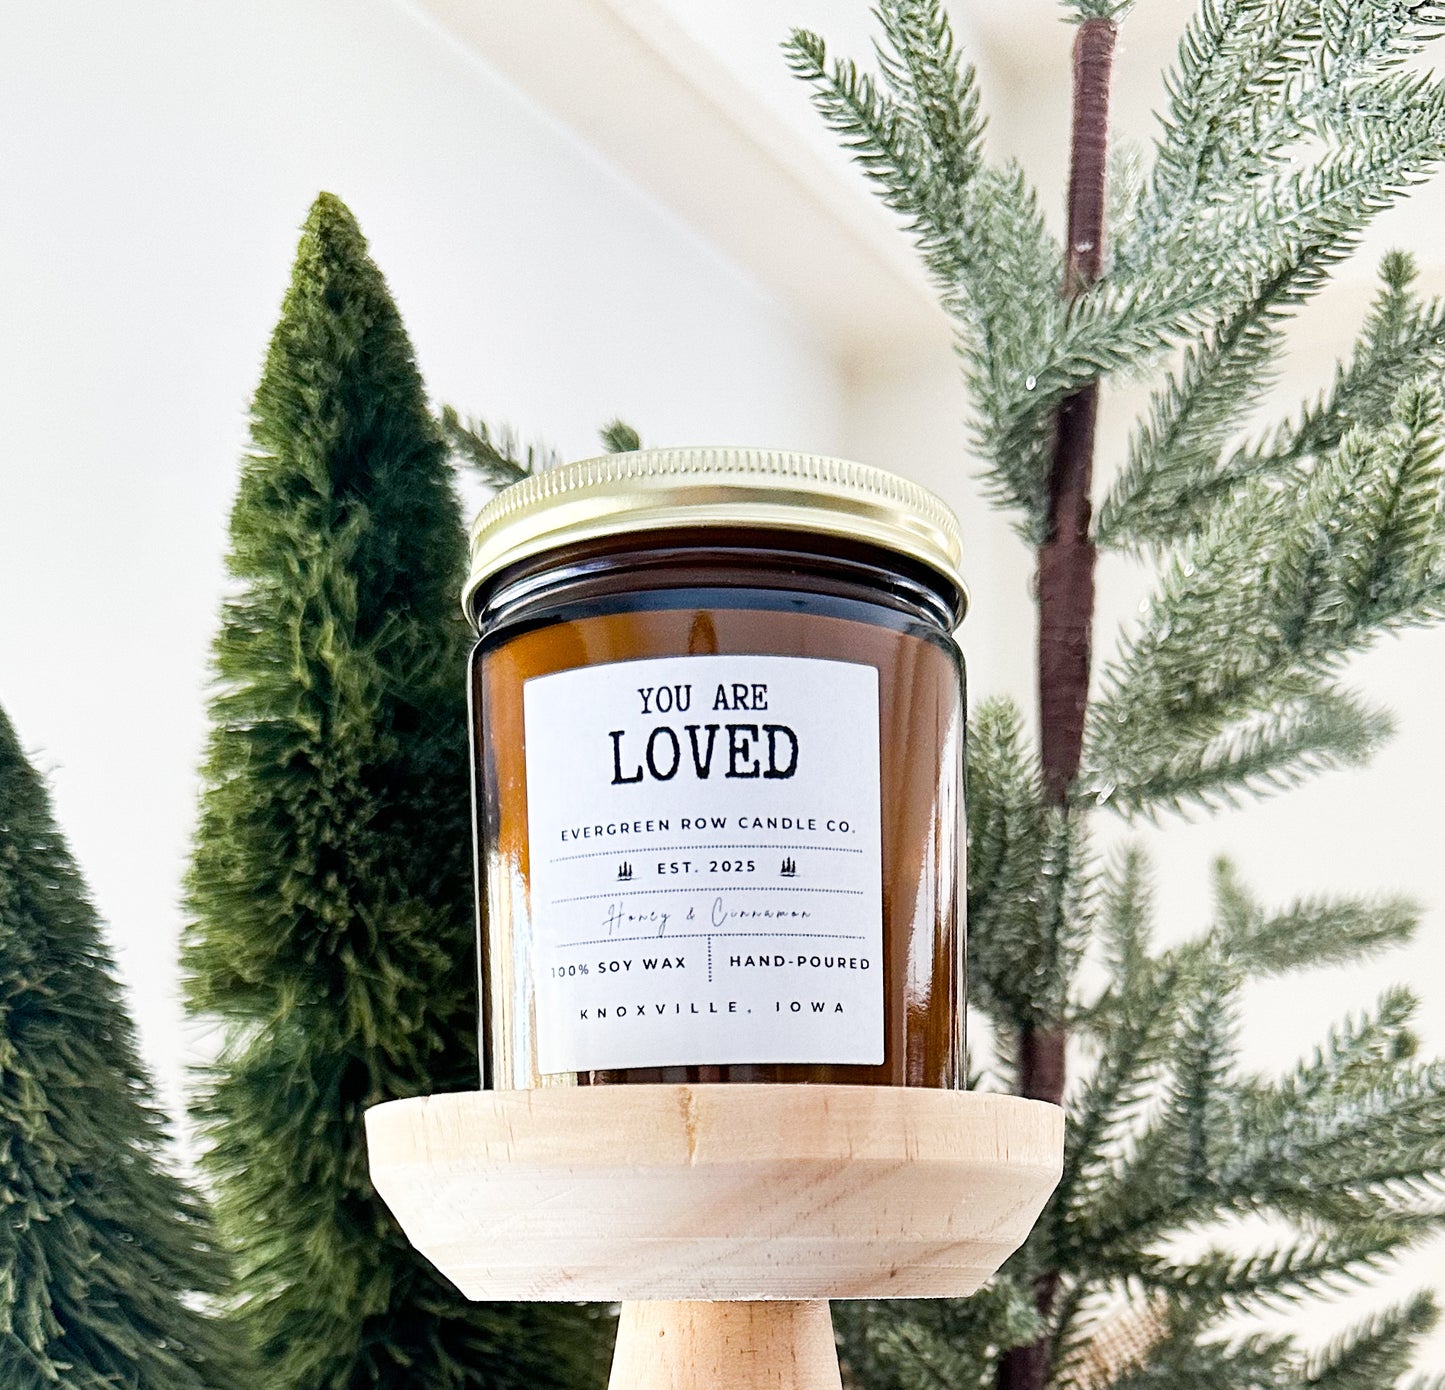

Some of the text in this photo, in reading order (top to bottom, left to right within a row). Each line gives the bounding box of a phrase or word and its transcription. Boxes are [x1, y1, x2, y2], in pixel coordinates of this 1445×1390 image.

[638, 683, 768, 714] YOU ARE
[608, 724, 799, 785] LOVED
[561, 817, 856, 841] EVERGREEN ROW CANDLE CO.
[657, 860, 756, 874] EST. 2025
[602, 901, 671, 936] Honey
[686, 906, 696, 921] &
[551, 956, 686, 979] 100% SOY WAX
[730, 955, 871, 971] HAND-POURED
[776, 1001, 845, 1014] IOWA
